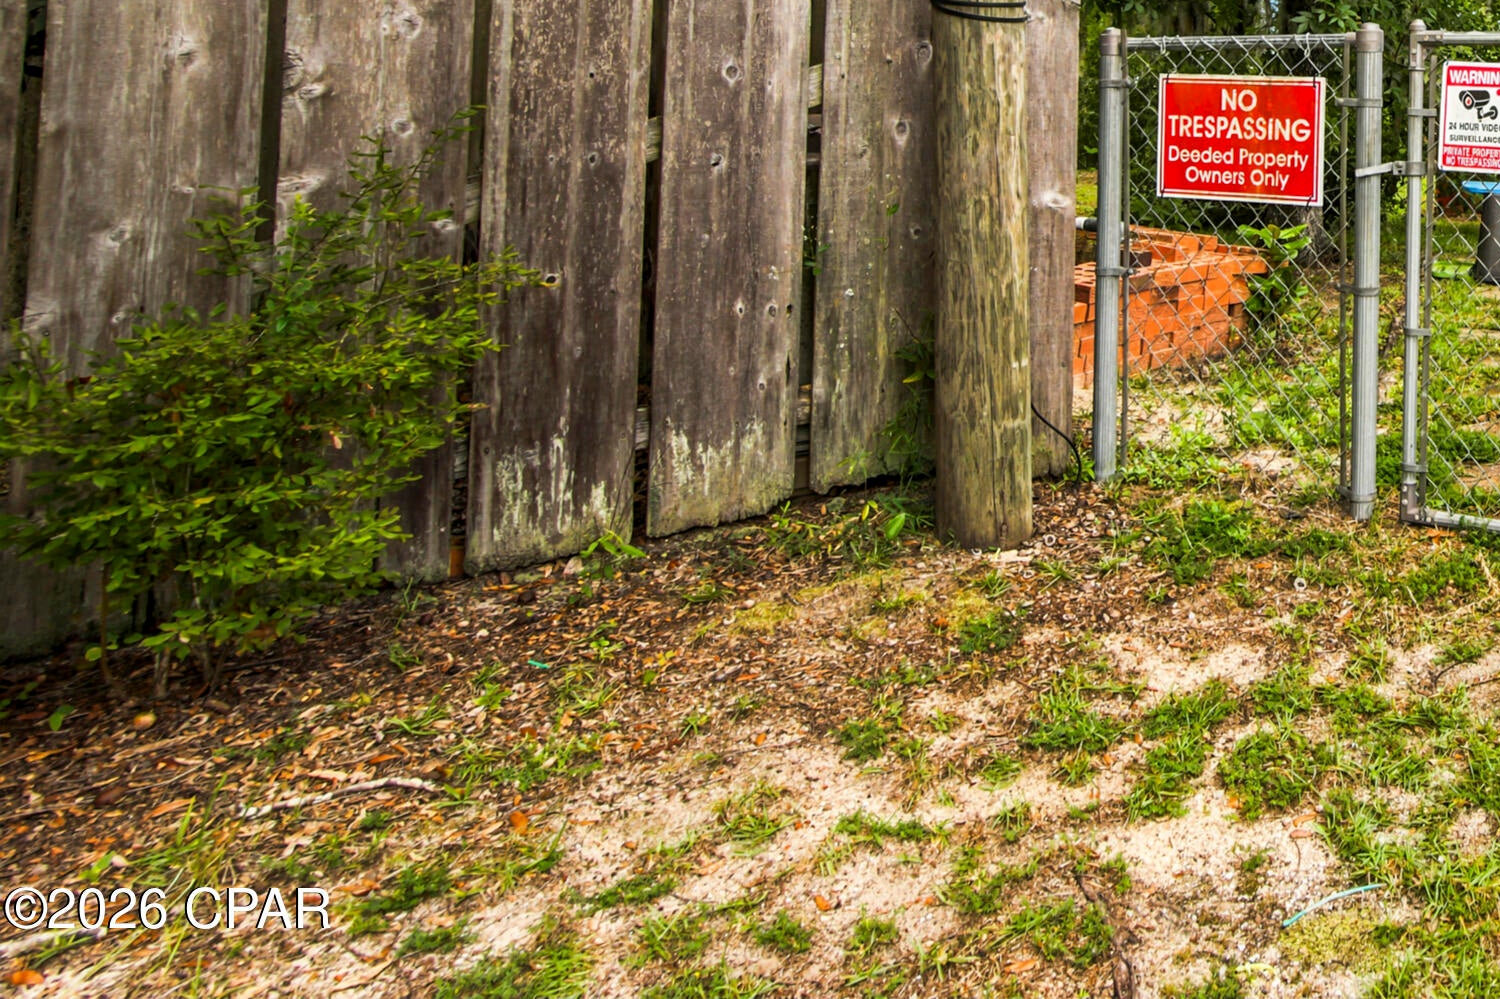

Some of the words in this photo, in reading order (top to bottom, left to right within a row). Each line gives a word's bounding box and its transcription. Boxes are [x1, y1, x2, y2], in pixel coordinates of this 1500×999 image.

[1221, 88, 1258, 112] NO
[1168, 115, 1312, 142] TRESPASSING
[1448, 121, 1457, 131] 24
[1459, 122, 1479, 131] HOUR
[1168, 145, 1234, 165] Deeded
[1239, 148, 1309, 172] Property
[1185, 166, 1245, 185] Owners
[1250, 169, 1289, 191] Only
